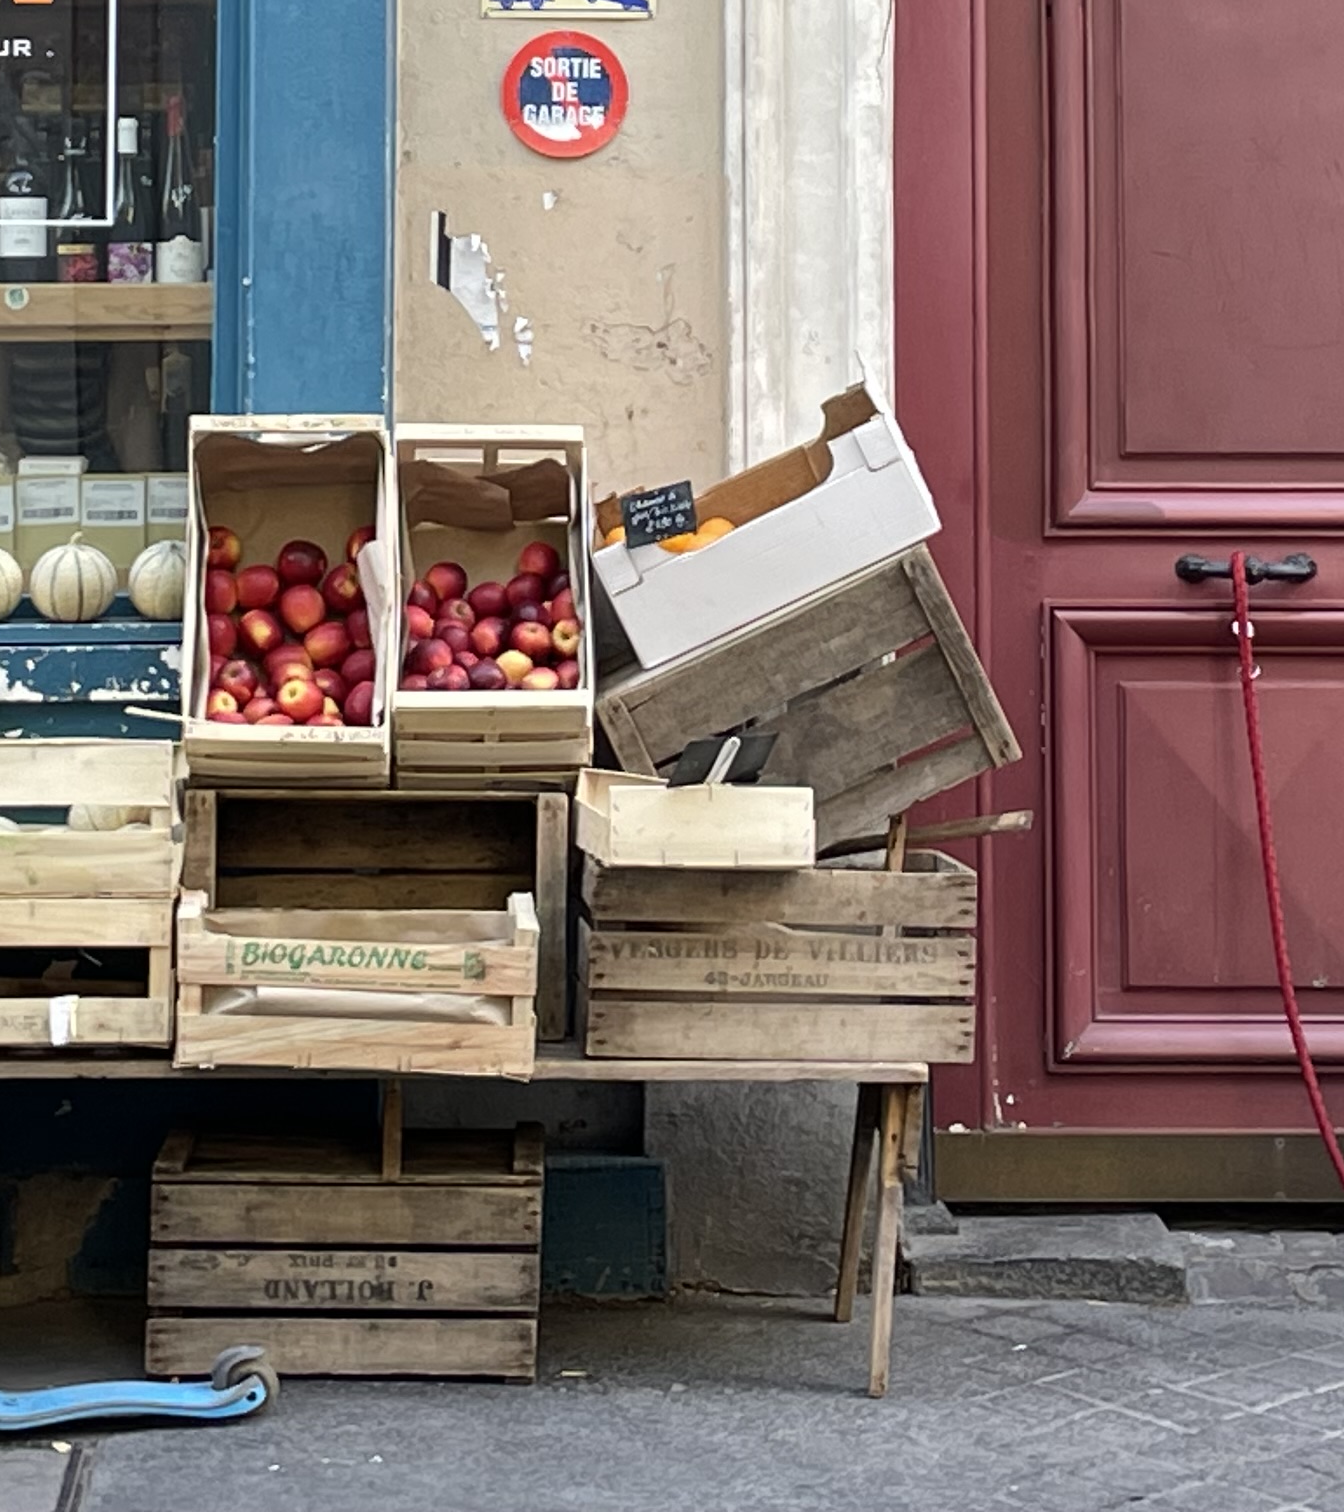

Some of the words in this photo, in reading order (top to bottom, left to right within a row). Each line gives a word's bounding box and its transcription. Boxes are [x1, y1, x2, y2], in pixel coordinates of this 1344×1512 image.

[530, 56, 602, 79] SORTIE
[551, 81, 579, 102] DE
[754, 939, 791, 961] DE
